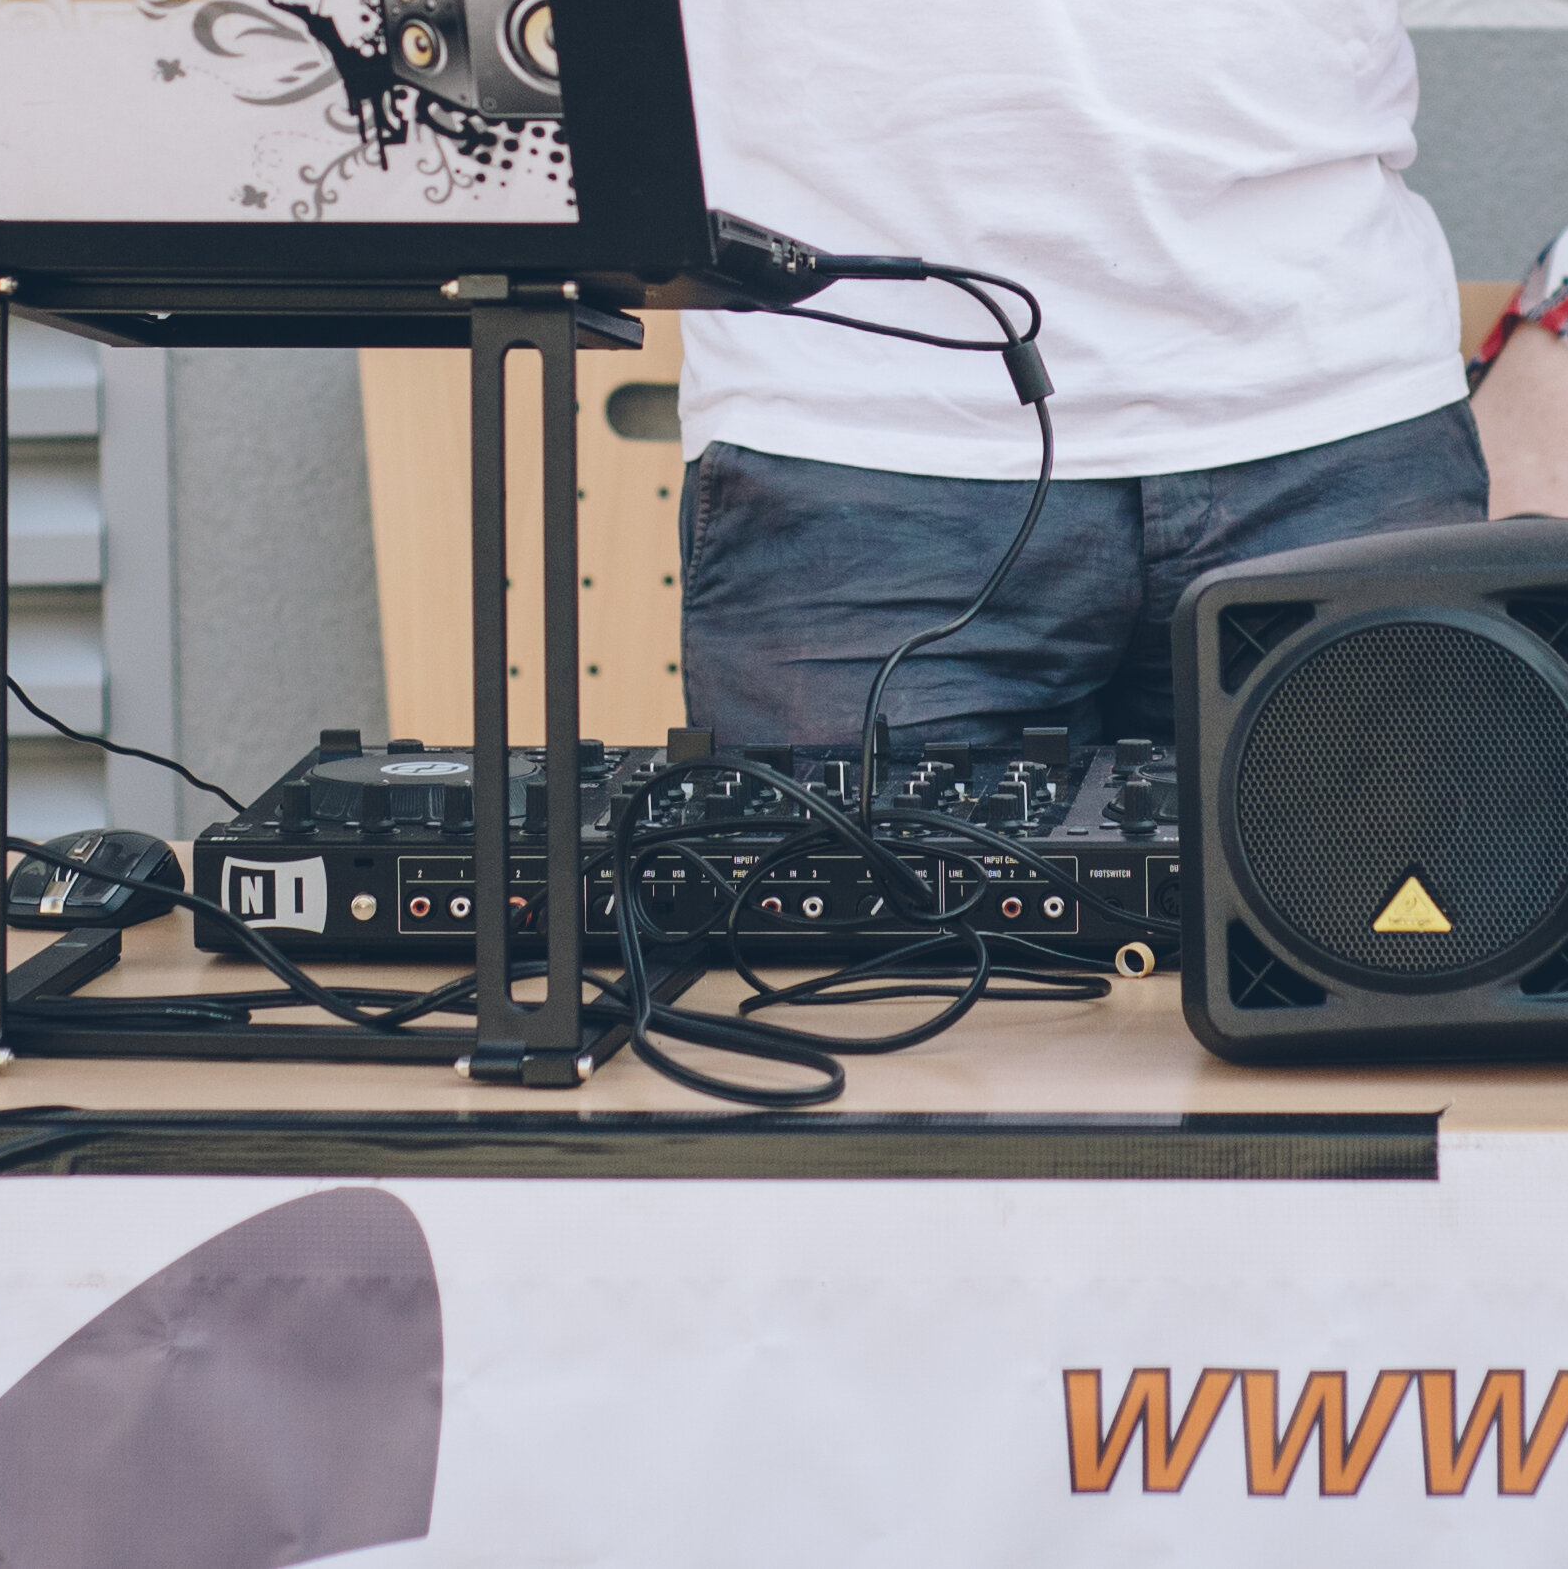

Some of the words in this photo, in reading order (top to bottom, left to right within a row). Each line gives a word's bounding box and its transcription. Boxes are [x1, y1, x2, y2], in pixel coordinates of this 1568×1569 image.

[673, 870, 686, 878] USB
[949, 870, 963, 878] LINE
[1089, 869, 1131, 878] FOOTSWITCH
